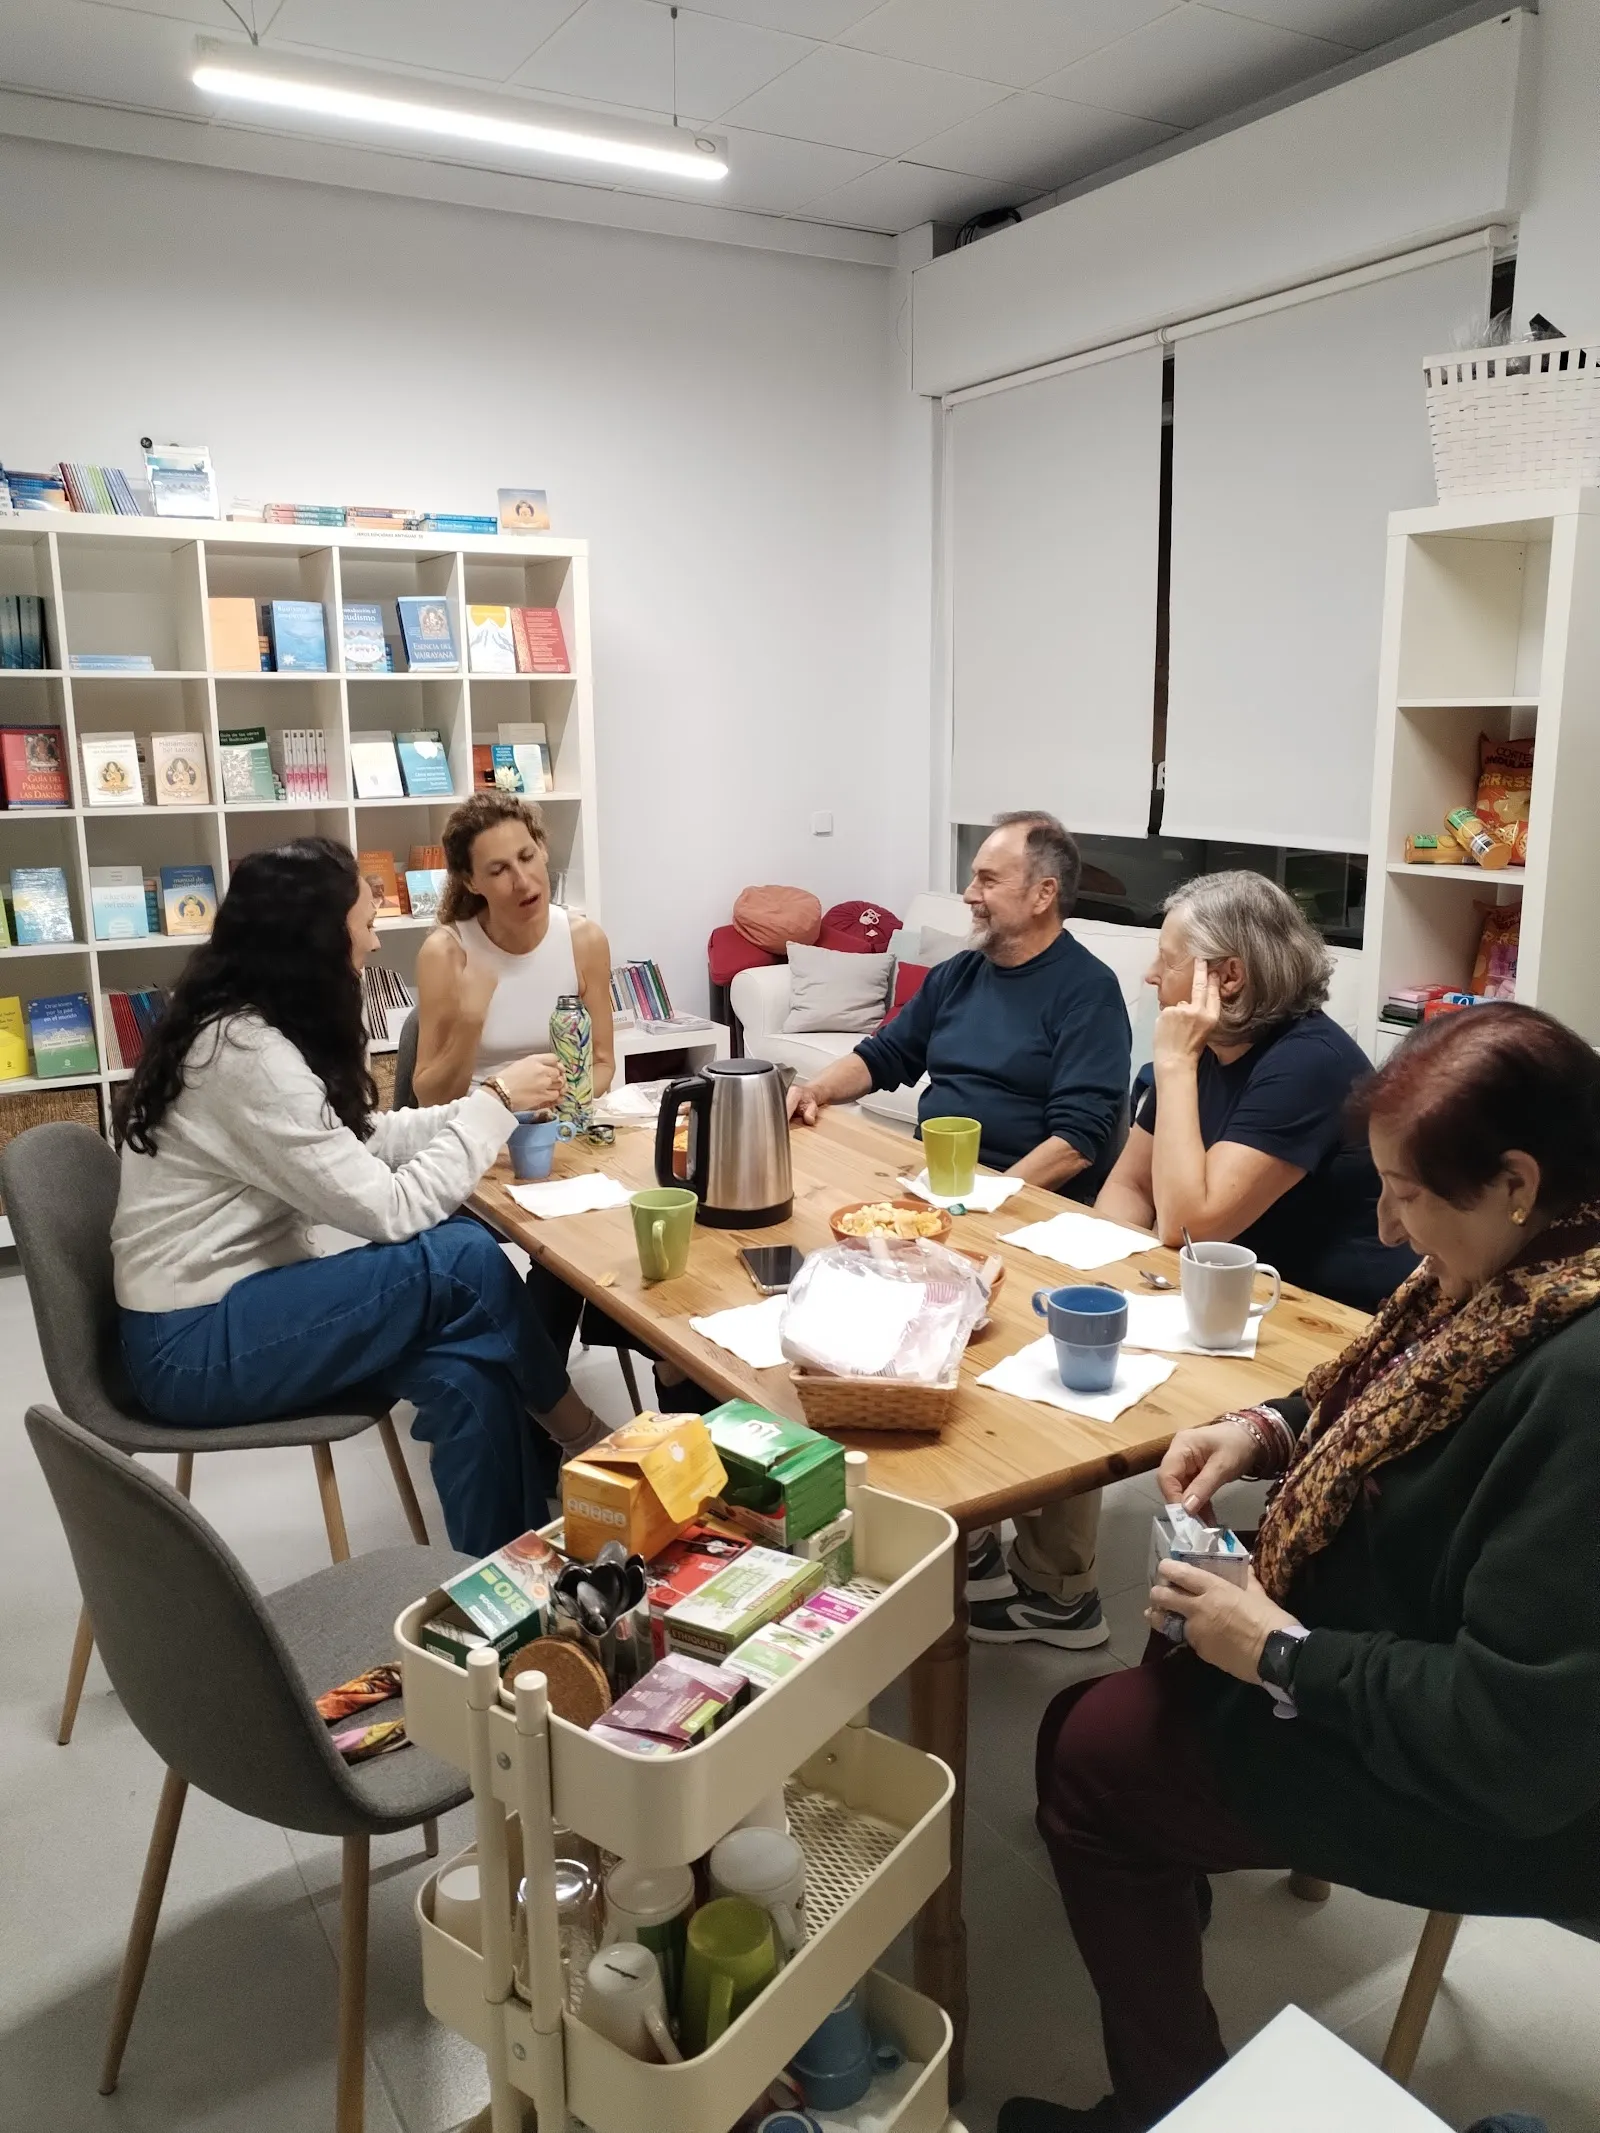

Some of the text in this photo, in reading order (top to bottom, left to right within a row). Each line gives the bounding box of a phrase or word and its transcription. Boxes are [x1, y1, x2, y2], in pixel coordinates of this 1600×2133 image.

[413, 642, 440, 650] ESENCIA
[58, 1013, 78, 1021] mundo
[478, 1593, 510, 1626] Rooibos
[493, 1581, 532, 1616] BIO
[670, 1627, 727, 1652] ETHIQUABLE
